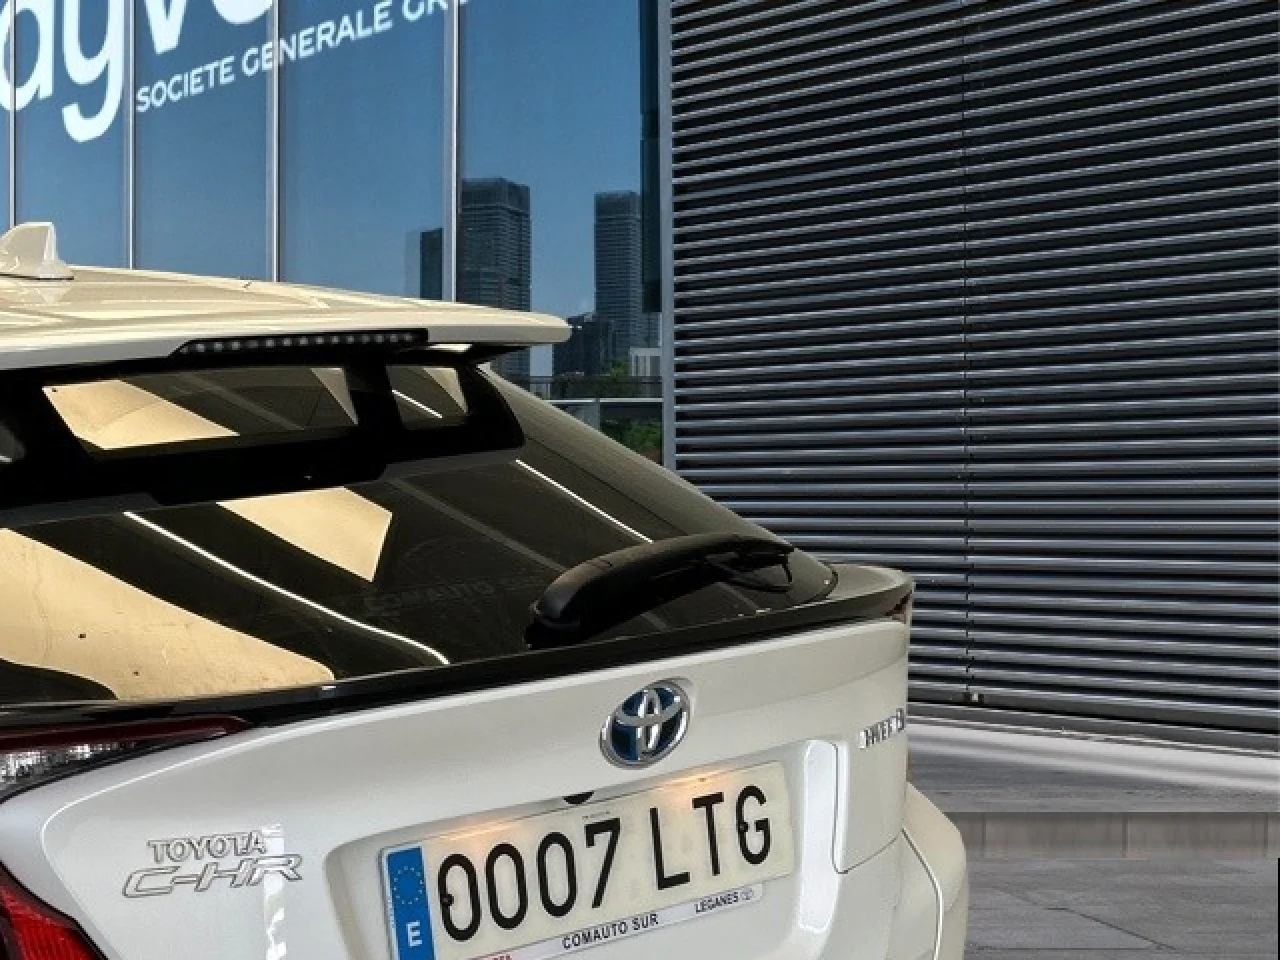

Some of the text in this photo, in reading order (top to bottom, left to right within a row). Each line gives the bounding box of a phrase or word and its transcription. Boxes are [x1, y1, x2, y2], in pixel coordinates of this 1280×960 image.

[135, 56, 236, 113] SOCIETE
[242, 0, 394, 77] GENERALE
[147, 830, 267, 863] TOYOTA
[437, 784, 772, 942] 0007 LTG
[122, 854, 302, 898] C-HR
[406, 920, 424, 947] E
[562, 920, 628, 950] COMAUTO
[633, 912, 660, 931] SUR
[694, 890, 739, 914] LEGANES
